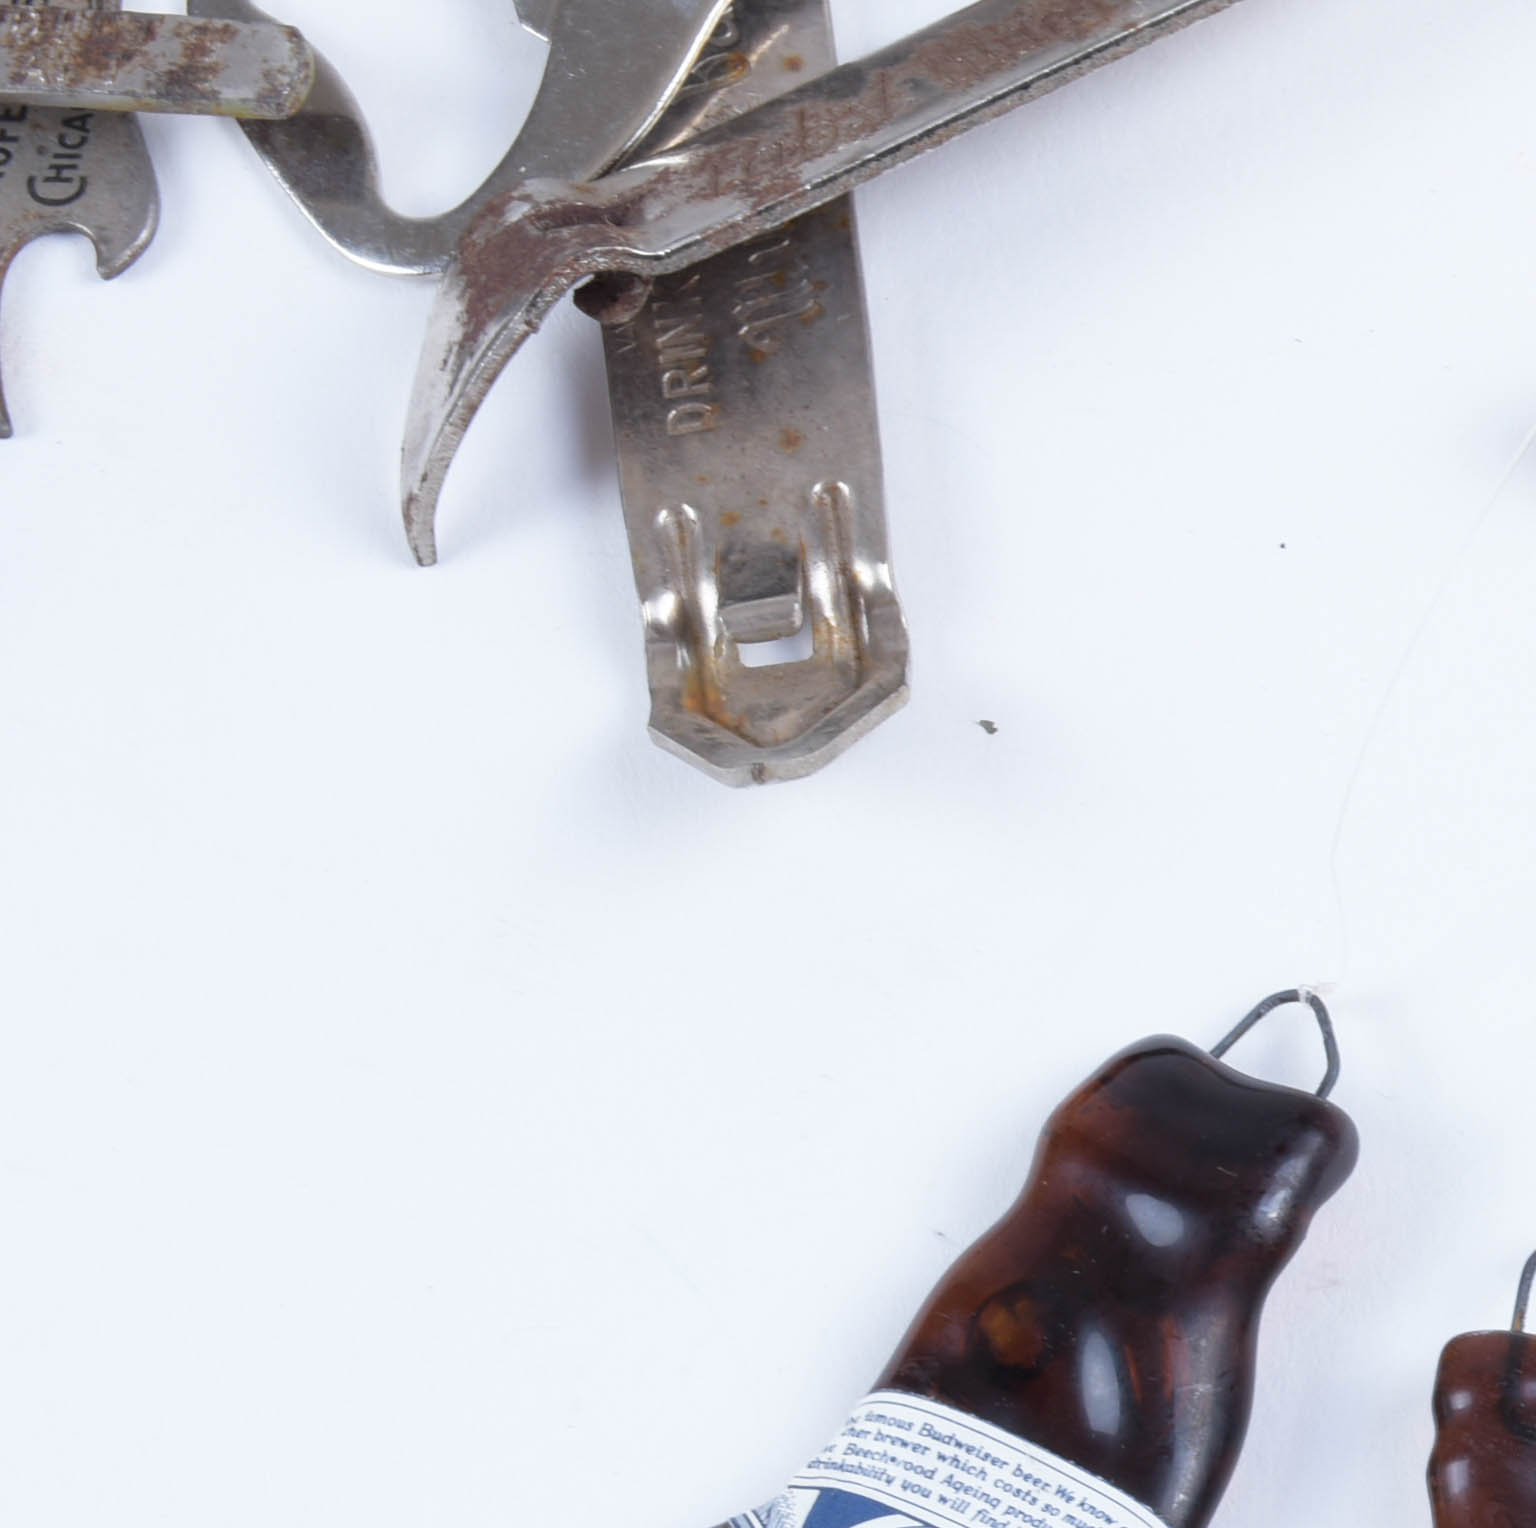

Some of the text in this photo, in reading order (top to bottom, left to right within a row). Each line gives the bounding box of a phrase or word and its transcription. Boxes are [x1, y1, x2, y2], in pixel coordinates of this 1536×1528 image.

[27, 106, 94, 206] CHICA
[873, 1428, 931, 1456] brewer
[936, 1451, 988, 1482] which
[994, 1478, 1039, 1506] costs
[1041, 1502, 1061, 1517] so
[901, 1480, 933, 1499] you
[937, 1494, 971, 1515] will
[918, 1422, 1009, 1470] Budweiser
[1077, 1498, 1118, 1526] know
[940, 1473, 1001, 1509] Ageing
